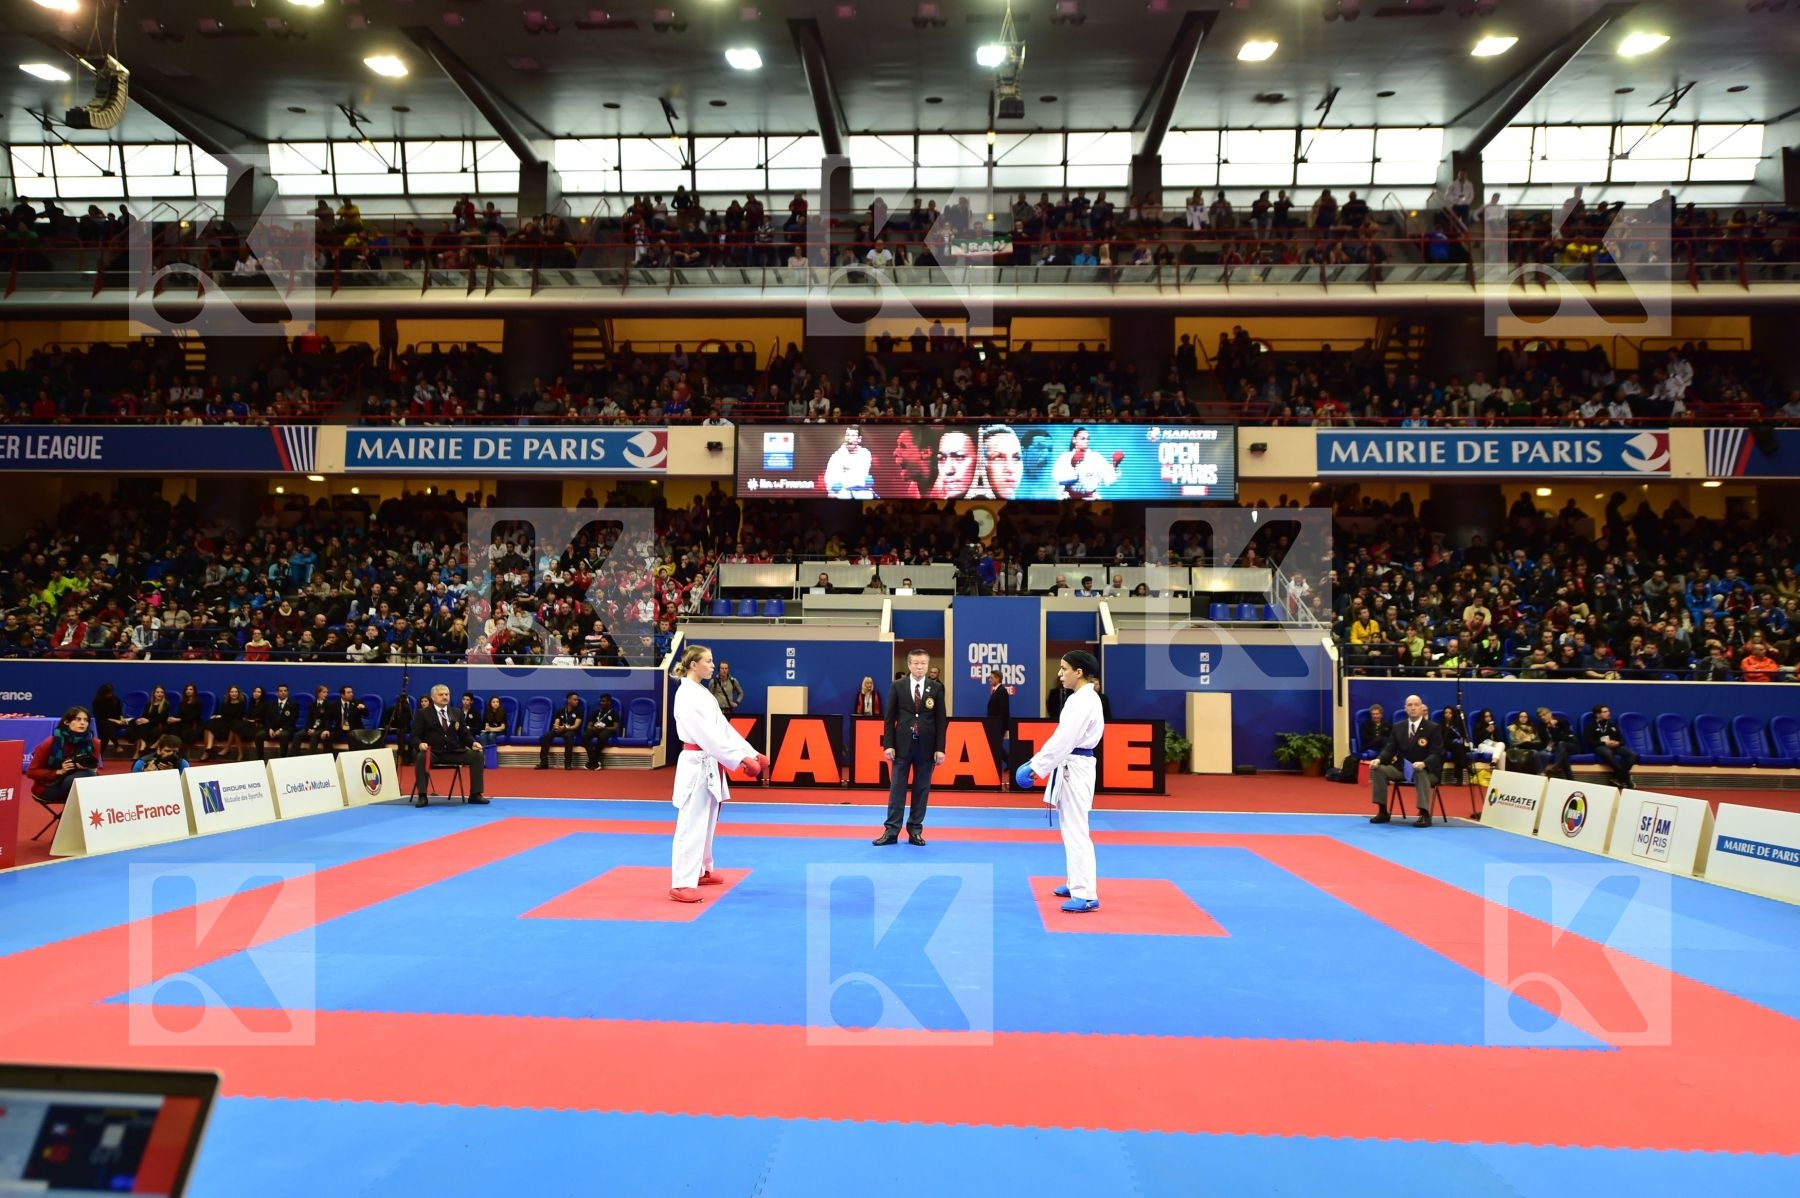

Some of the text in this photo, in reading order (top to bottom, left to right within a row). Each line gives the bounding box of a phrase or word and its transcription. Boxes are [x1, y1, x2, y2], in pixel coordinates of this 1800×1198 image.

[25, 435, 103, 459] LEAGUE
[357, 437, 605, 460] MAIRIE DE PARIS
[1159, 443, 1199, 464] OPEN
[1330, 440, 1603, 463] MAIRIE DE PARIS
[968, 643, 1008, 664] OPEN
[970, 664, 1026, 685] DE PRIS
[222, 784, 247, 792] GROUPE
[310, 779, 331, 790] Mutuel
[1723, 839, 1799, 863] MAIRIE DE PARIS
